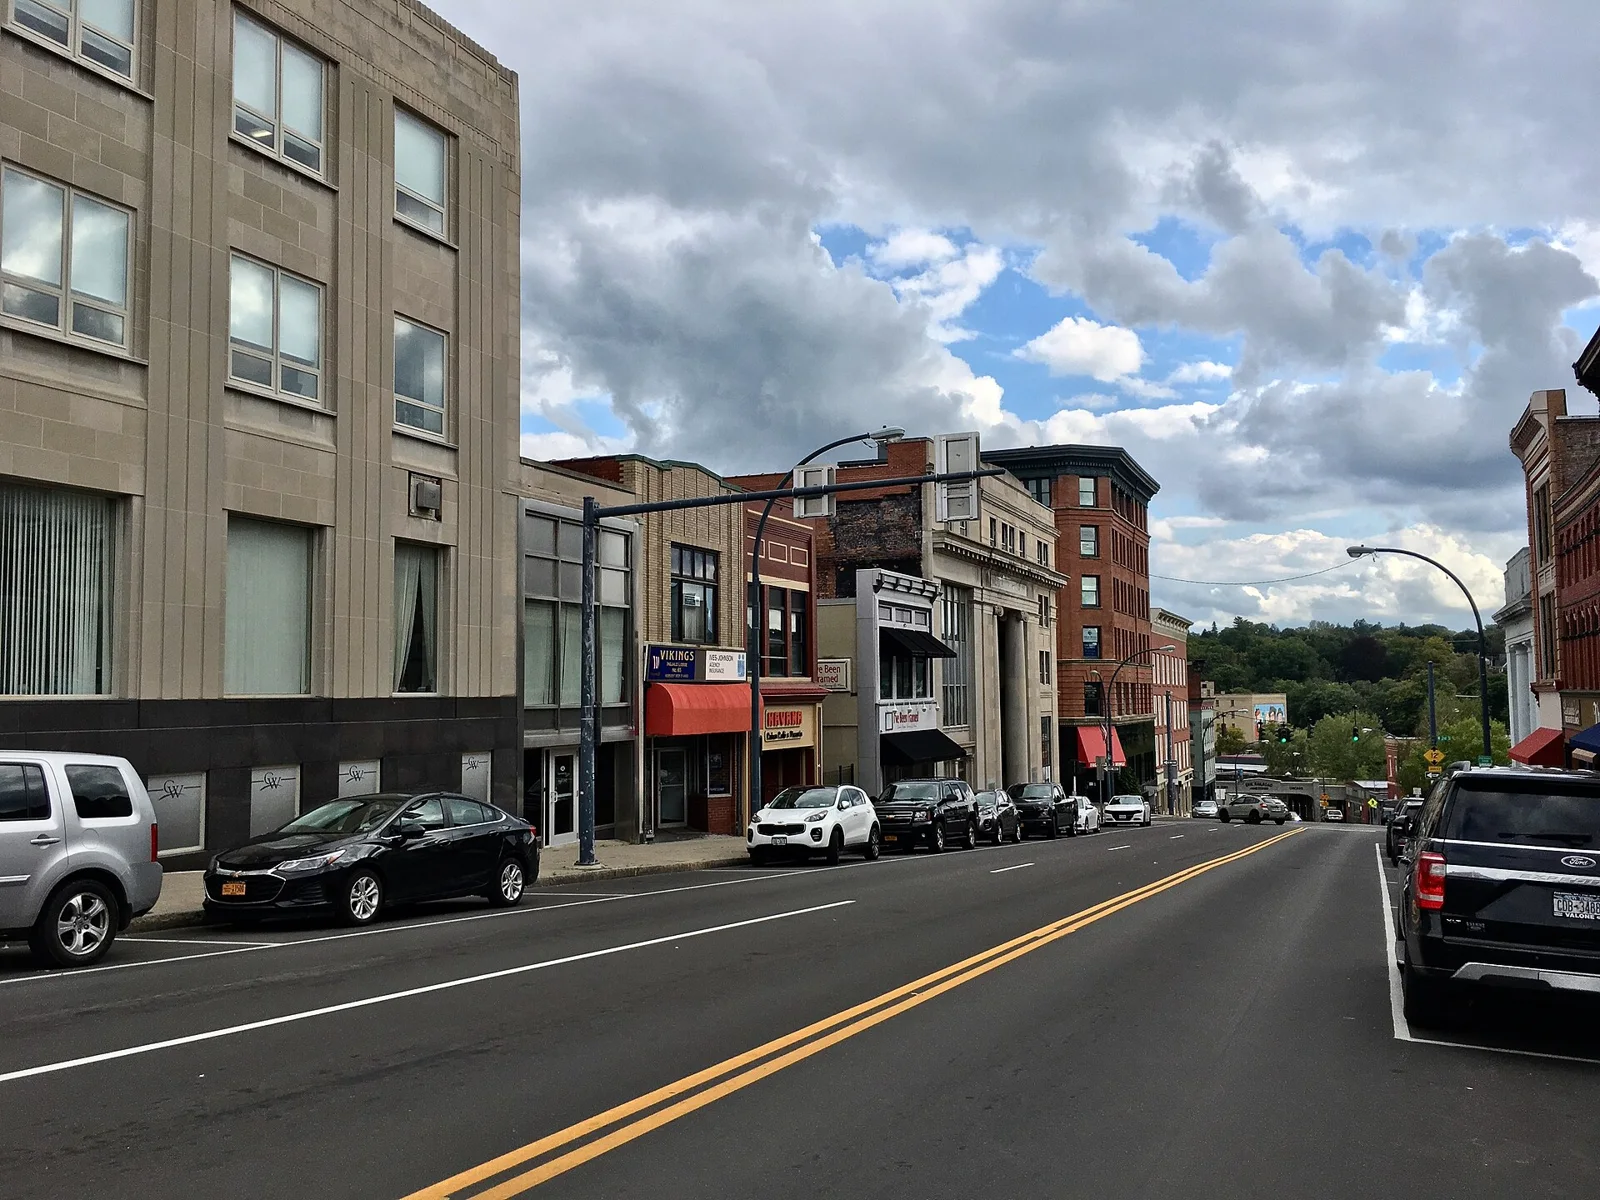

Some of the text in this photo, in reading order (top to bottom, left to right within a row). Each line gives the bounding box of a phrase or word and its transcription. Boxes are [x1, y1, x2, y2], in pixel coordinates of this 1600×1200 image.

[660, 650, 694, 661] VIKINGS
[824, 664, 841, 674] Been
[817, 674, 838, 683] ramed
[766, 711, 802, 727] HAVANA
[1564, 912, 1595, 920] VALONE
